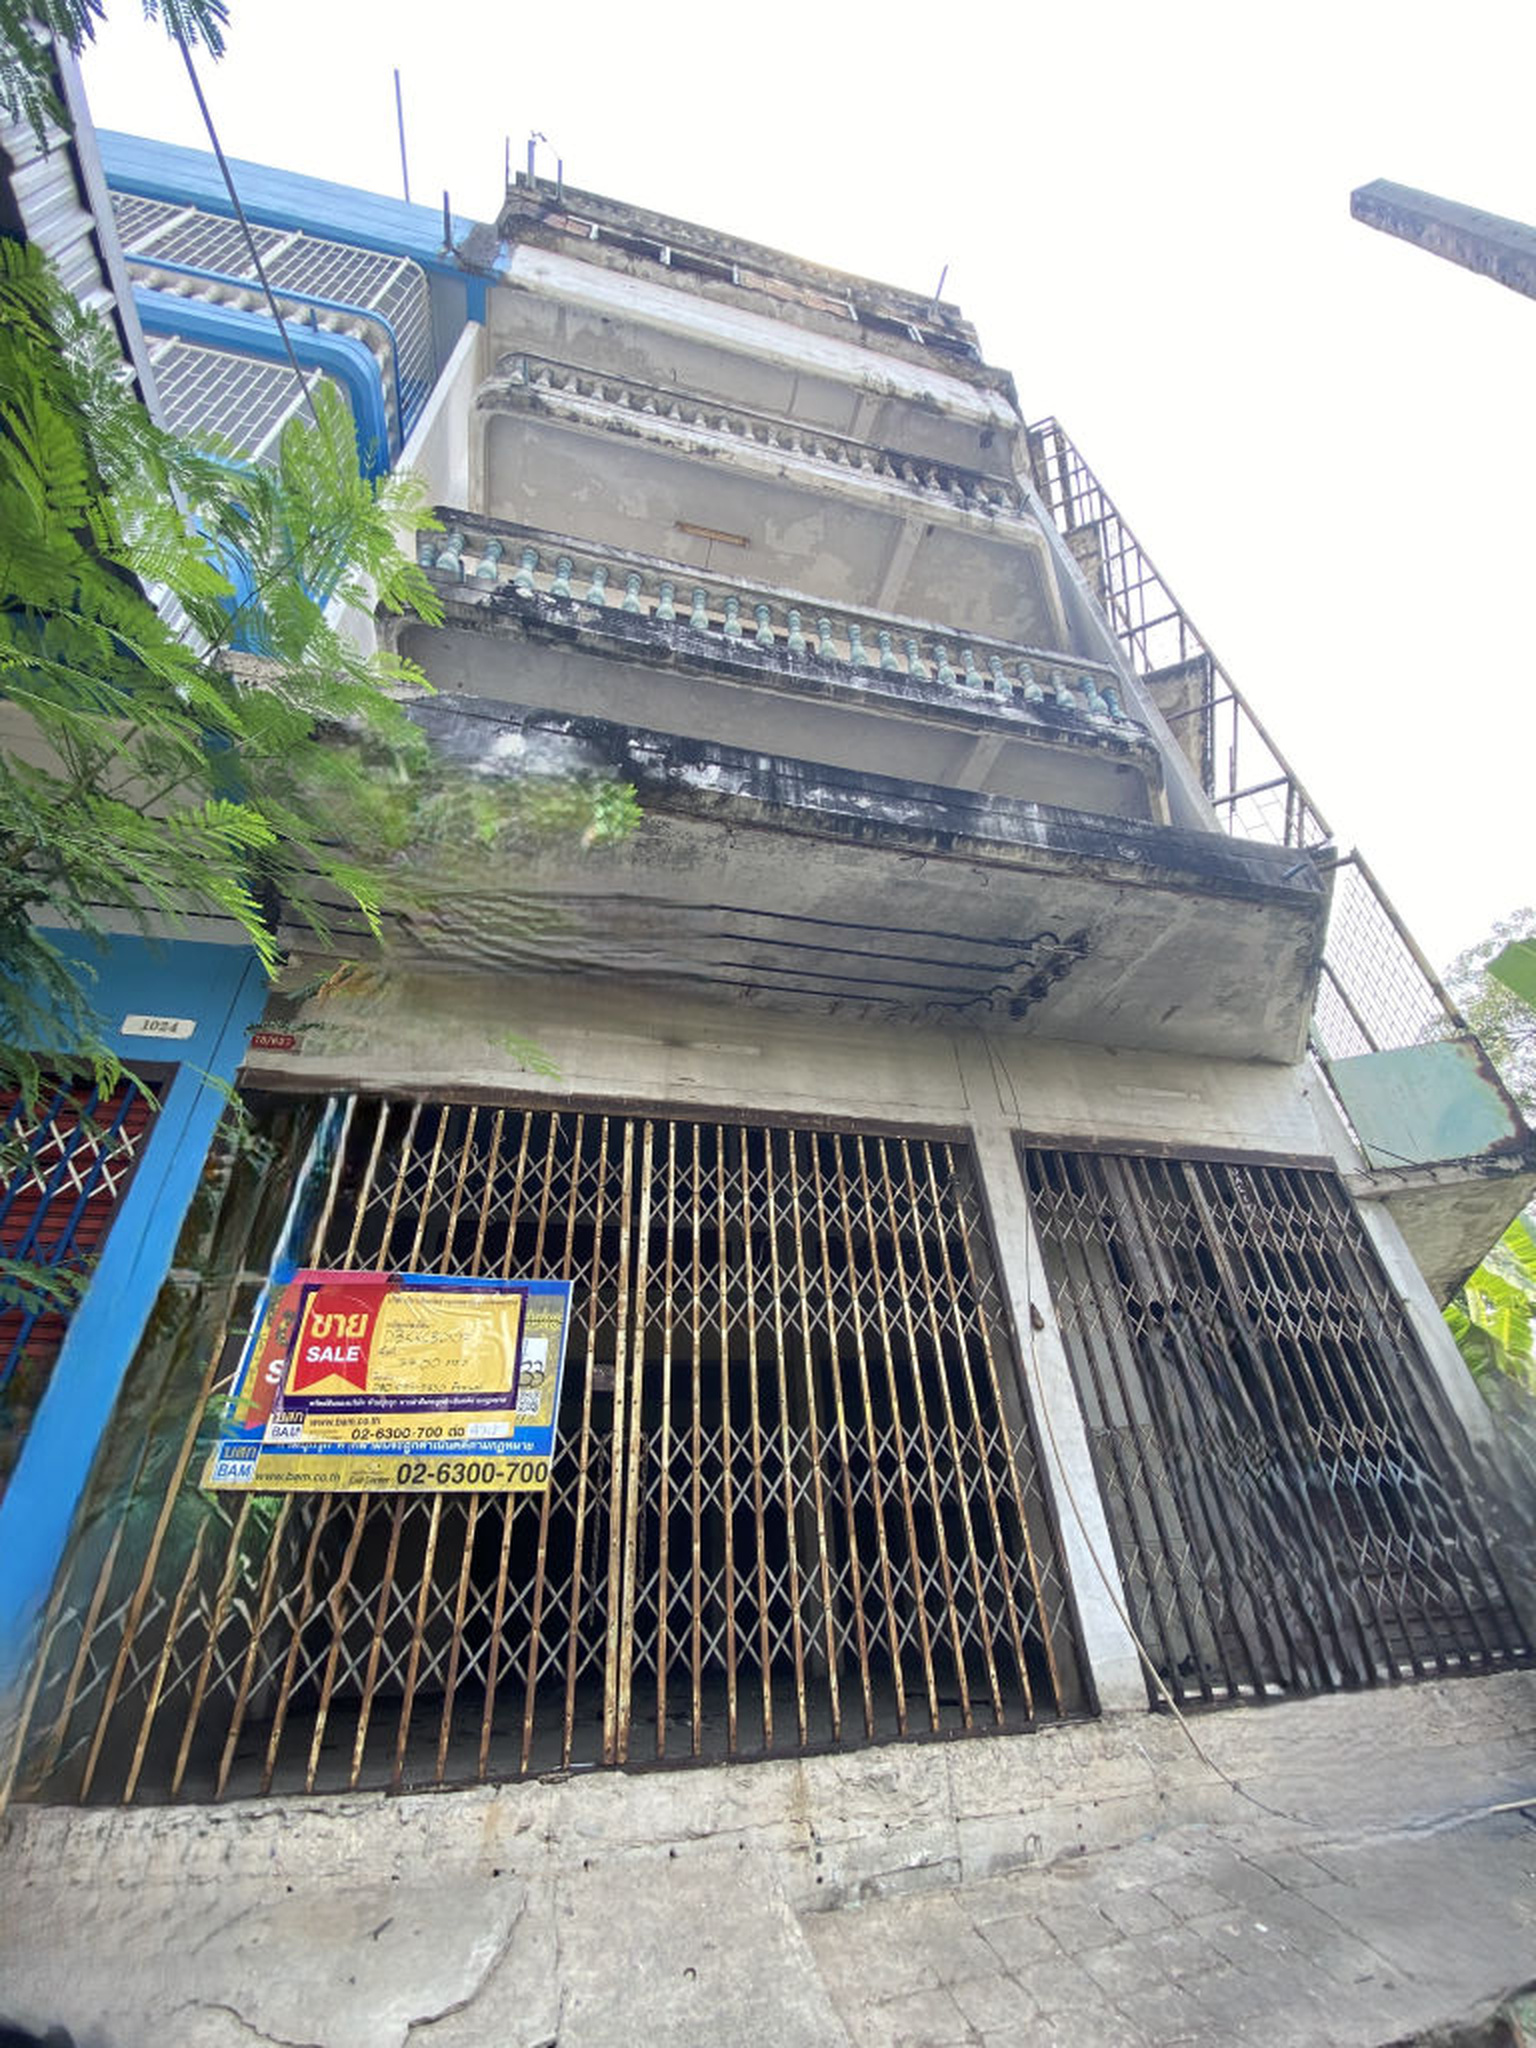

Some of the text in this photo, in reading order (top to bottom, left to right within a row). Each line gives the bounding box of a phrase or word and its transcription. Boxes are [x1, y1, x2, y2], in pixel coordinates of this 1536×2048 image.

[142, 1018, 179, 1033] 1024
[310, 1313, 368, 1338] ขาย
[305, 1346, 361, 1363] SALE
[217, 1464, 250, 1478] BAM
[396, 1462, 548, 1485] 02-6300-700
